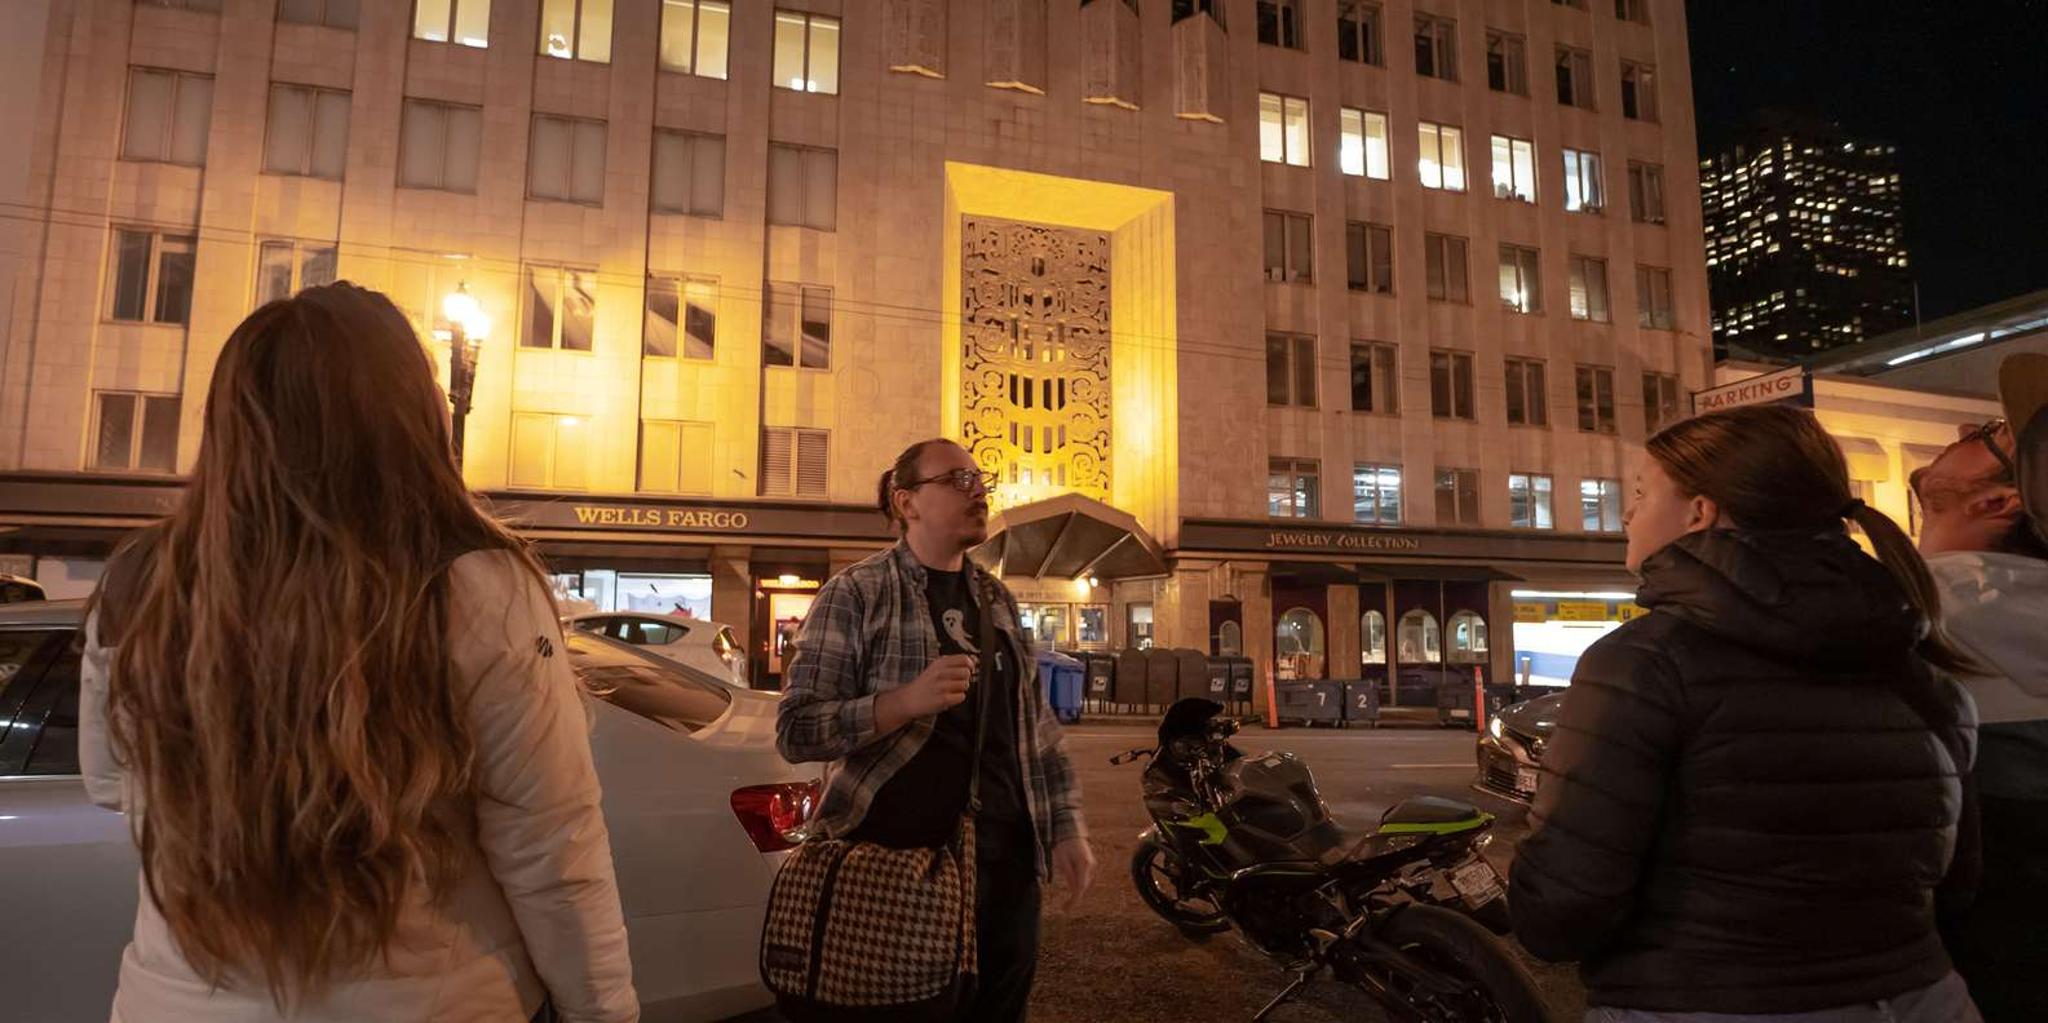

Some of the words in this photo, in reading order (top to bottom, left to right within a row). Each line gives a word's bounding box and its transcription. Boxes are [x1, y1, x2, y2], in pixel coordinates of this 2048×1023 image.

[1700, 376, 1791, 409] PARKING
[574, 507, 661, 525] WELLS
[667, 510, 747, 528] FARGO
[1266, 532, 1332, 547] JEWELRY
[1336, 534, 1419, 548] COLLECTION
[1317, 691, 1326, 707] 7
[1357, 693, 1368, 709] 2
